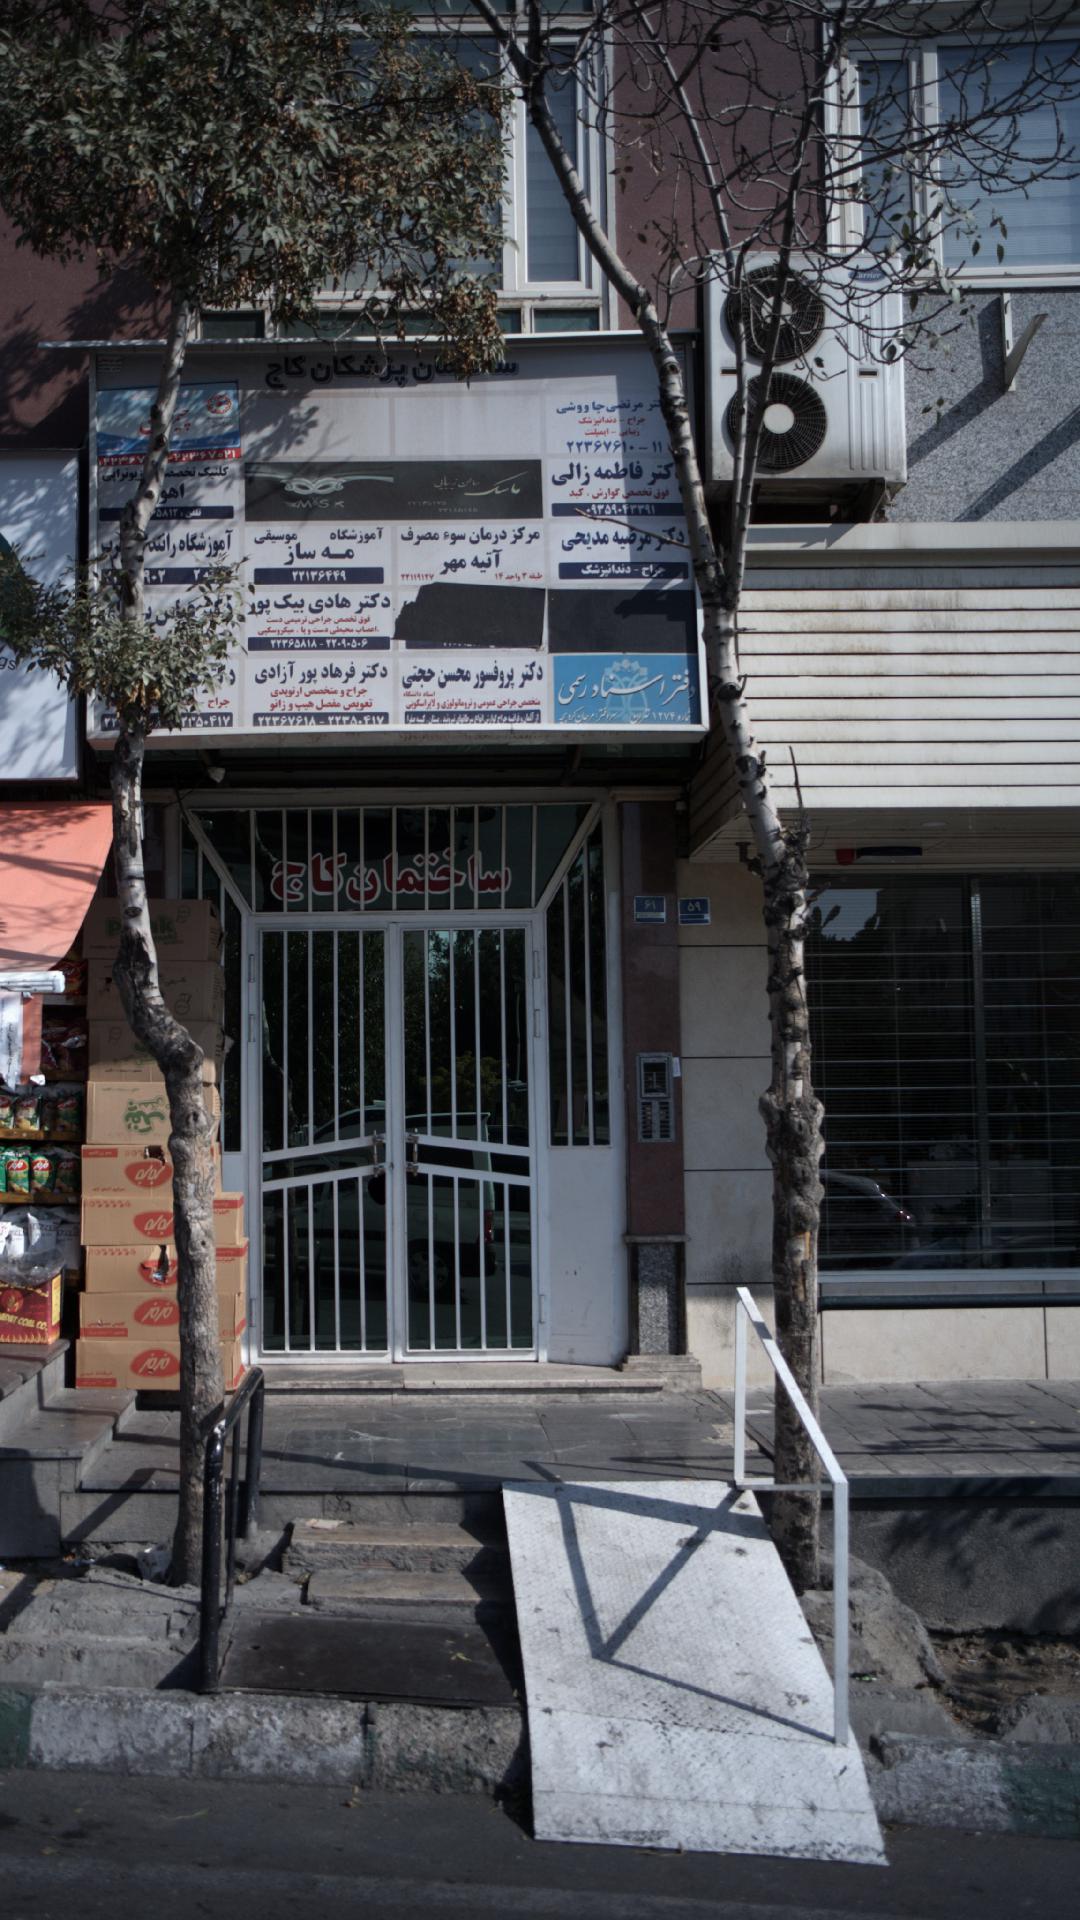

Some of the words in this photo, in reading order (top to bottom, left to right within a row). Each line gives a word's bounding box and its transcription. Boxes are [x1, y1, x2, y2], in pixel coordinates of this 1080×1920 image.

[265, 355, 305, 389] کاج
[310, 355, 409, 387] پزشکان
[627, 416, 646, 425] جراح
[566, 440, 634, 453] ۲۲۳۶۷۶۱۰
[551, 461, 591, 486] زالی
[593, 460, 644, 480] فاطمه
[648, 461, 677, 485] کتر
[568, 487, 584, 498] کبد
[178, 529, 234, 558] آموزشگاه
[254, 528, 298, 545] موسیقی
[329, 526, 385, 544] آموزشگاه
[400, 526, 440, 546] مصرف
[443, 530, 466, 546] سوء
[468, 526, 508, 545] درمان
[510, 525, 541, 545] مرکز
[561, 529, 610, 551] مدیحی
[283, 542, 317, 566] ساز
[470, 549, 503, 573] آتیه
[291, 569, 347, 581] ۲۲۱۳۶۴۴۹
[440, 557, 467, 575] مهر
[580, 563, 632, 578] دندانپزشک
[641, 563, 666, 578] جراح
[247, 598, 271, 616] پور
[308, 593, 351, 614] هادی
[355, 592, 391, 614] دکتر
[308, 615, 332, 625] جراحی
[270, 638, 318, 649] ۲۲۳۶۵۸۱۸
[326, 638, 368, 648] ۲۲۰۹۰۵۰۶
[254, 660, 296, 685] آزادی
[298, 666, 317, 685] پور
[320, 661, 356, 684] فرهاد
[358, 662, 389, 684] دکتر
[401, 664, 436, 689] حجتی
[438, 666, 472, 689] محسن
[473, 660, 515, 690] پروفسور
[518, 660, 544, 688] دکتر
[303, 687, 339, 698] متخصص
[345, 686, 368, 697] جراح
[591, 673, 665, 698] اسناد
[207, 697, 231, 709] جراح
[269, 699, 286, 712] زانو
[315, 699, 341, 711] مفصل
[342, 699, 373, 711] تعویض
[496, 698, 517, 709] جراحی
[270, 852, 347, 901] کاج
[346, 848, 512, 904] ساختمان
